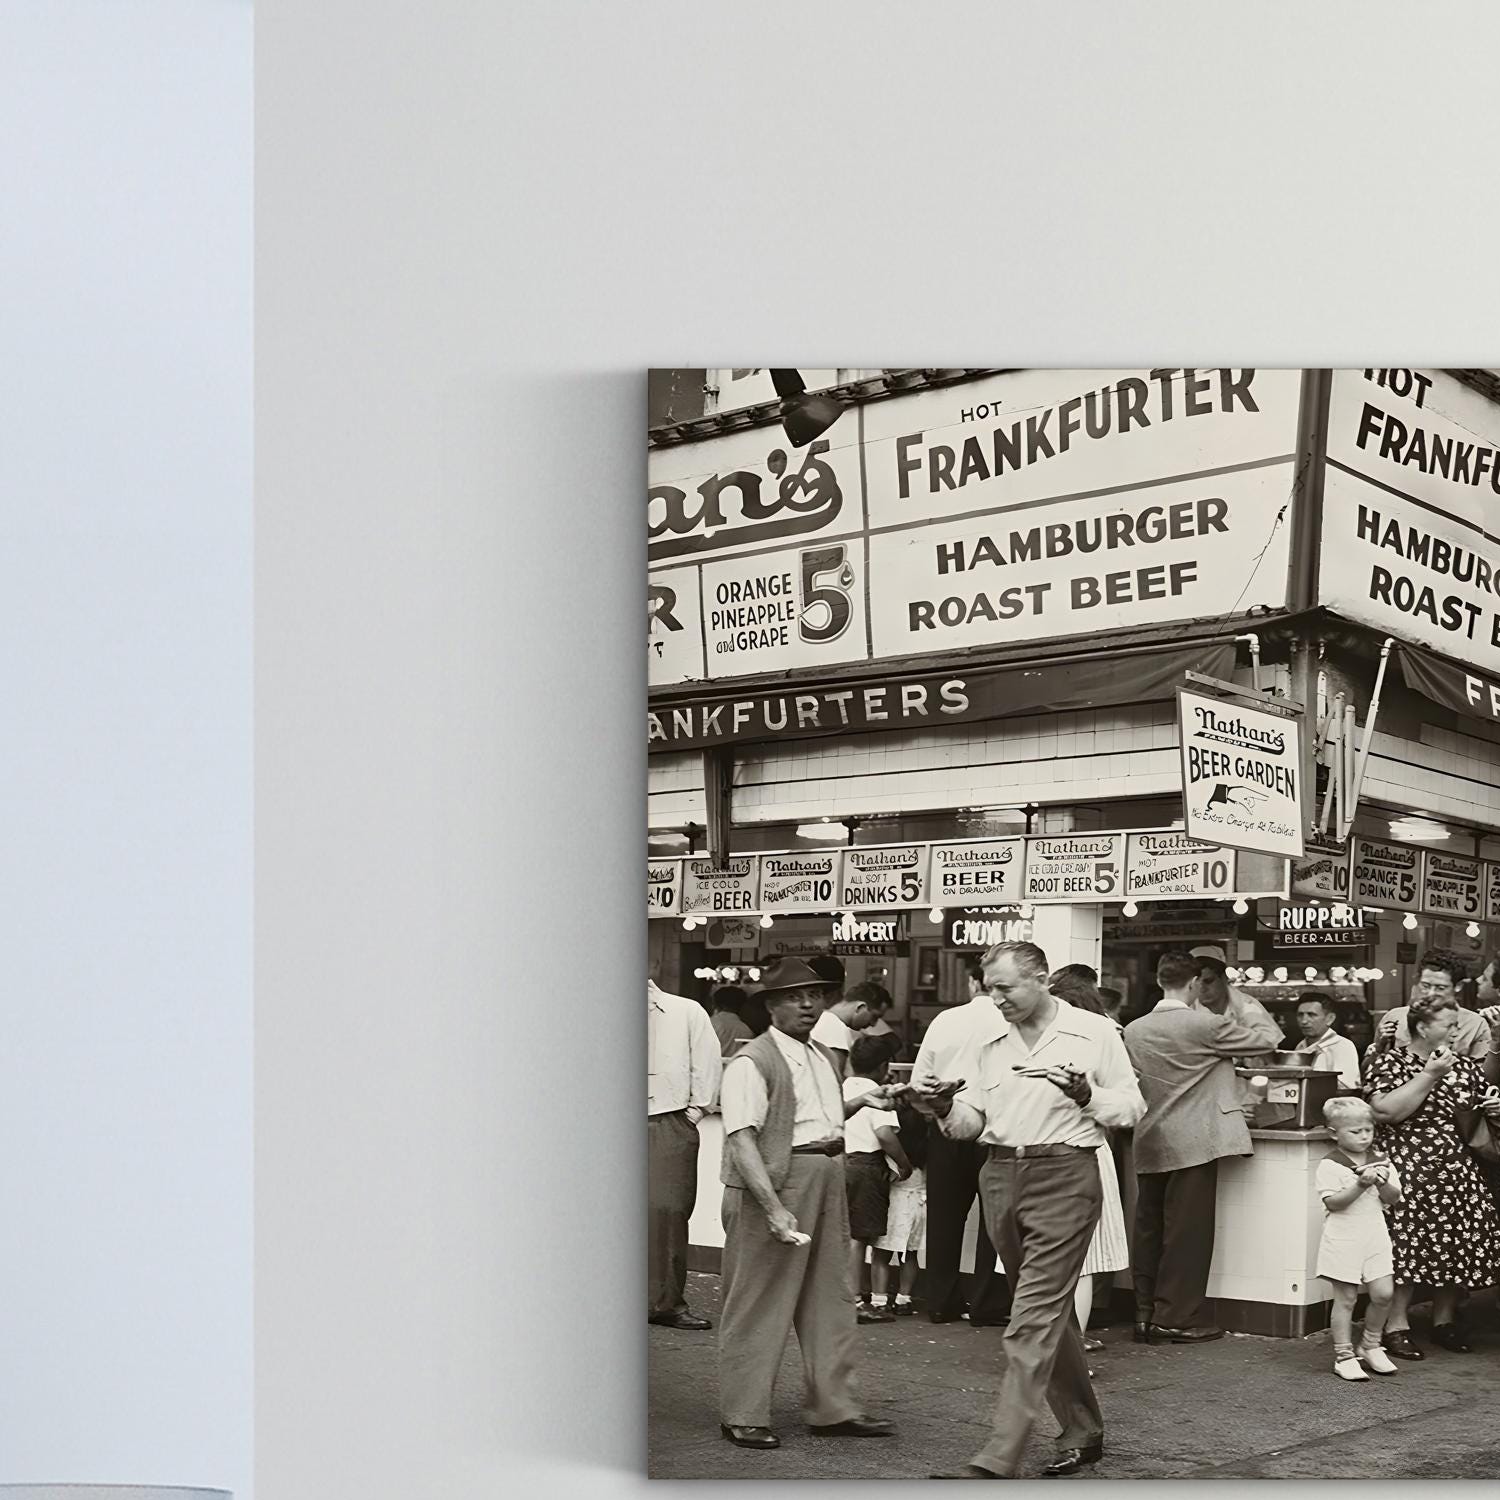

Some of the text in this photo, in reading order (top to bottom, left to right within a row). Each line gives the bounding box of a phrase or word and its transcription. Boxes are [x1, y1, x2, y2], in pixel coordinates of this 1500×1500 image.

[961, 401, 1003, 423] HOT
[896, 368, 1260, 499] FRANKFURTER
[936, 497, 1230, 575] HAMBURGER
[716, 572, 793, 605] ORANGE
[908, 560, 1198, 632] ROAST BEEF
[1369, 564, 1483, 640] ROAST
[711, 600, 795, 631] PINEAPPLE
[736, 626, 789, 651] GRAPE
[1194, 706, 1285, 748] Nathan's
[1188, 745, 1296, 802] BEER GARDEN
[936, 846, 1013, 863] Nathan's
[1035, 837, 1114, 855] Nathan's
[765, 858, 833, 872] Nathan's
[850, 848, 919, 866] Nathan's
[696, 880, 741, 890] ICE COLD
[865, 873, 888, 884] SOFT
[943, 870, 1005, 887] BEER
[1029, 877, 1061, 893] ROOT
[1063, 876, 1092, 893] BEER
[1128, 862, 1199, 890] FRANKFURTER
[1354, 865, 1399, 886] ORANGE
[844, 885, 898, 905] DRINKS
[942, 888, 956, 896] ON
[1359, 882, 1396, 900] DRINK
[1426, 877, 1465, 895] PINEAPPLE
[713, 890, 752, 911] BEER
[1284, 932, 1350, 944] BEER-ALE
